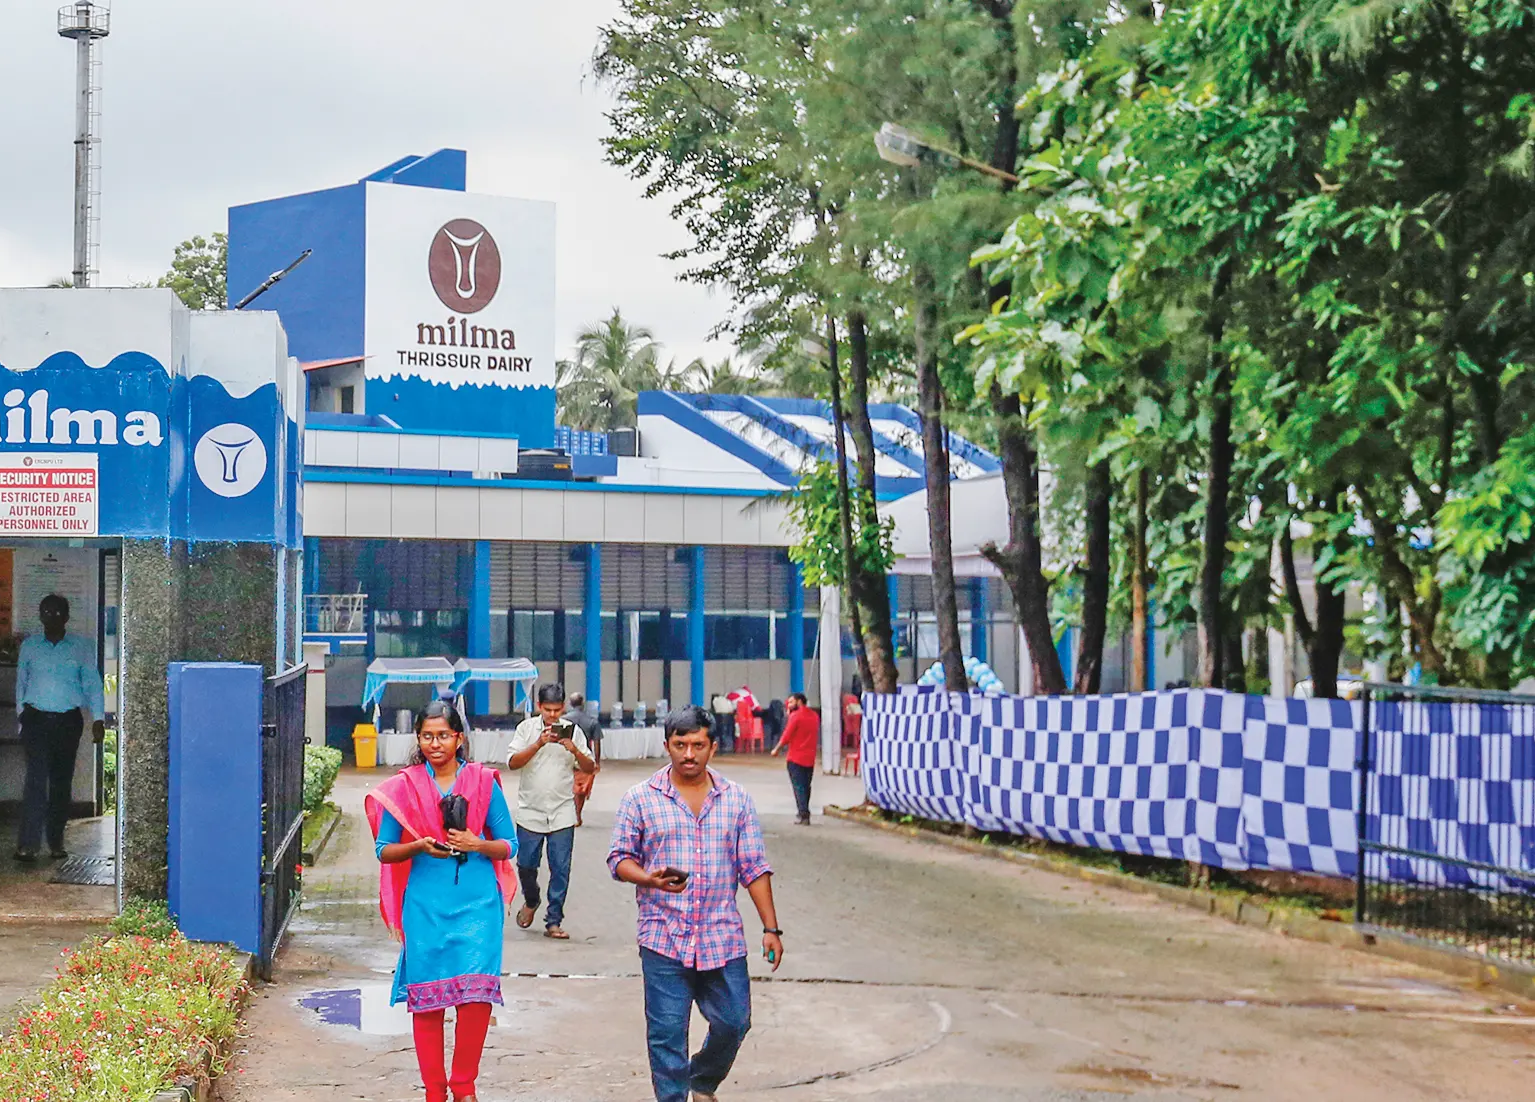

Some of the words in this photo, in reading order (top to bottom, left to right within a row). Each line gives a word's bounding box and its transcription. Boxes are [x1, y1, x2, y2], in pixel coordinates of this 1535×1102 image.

[417, 316, 516, 350] milma
[397, 350, 481, 370] THRISSUR
[487, 355, 533, 373] DAIRY
[52, 473, 94, 485] NOTICE
[64, 492, 92, 503] AREA
[9, 506, 76, 517] AUTHORIZED
[62, 520, 89, 530] ONLY
